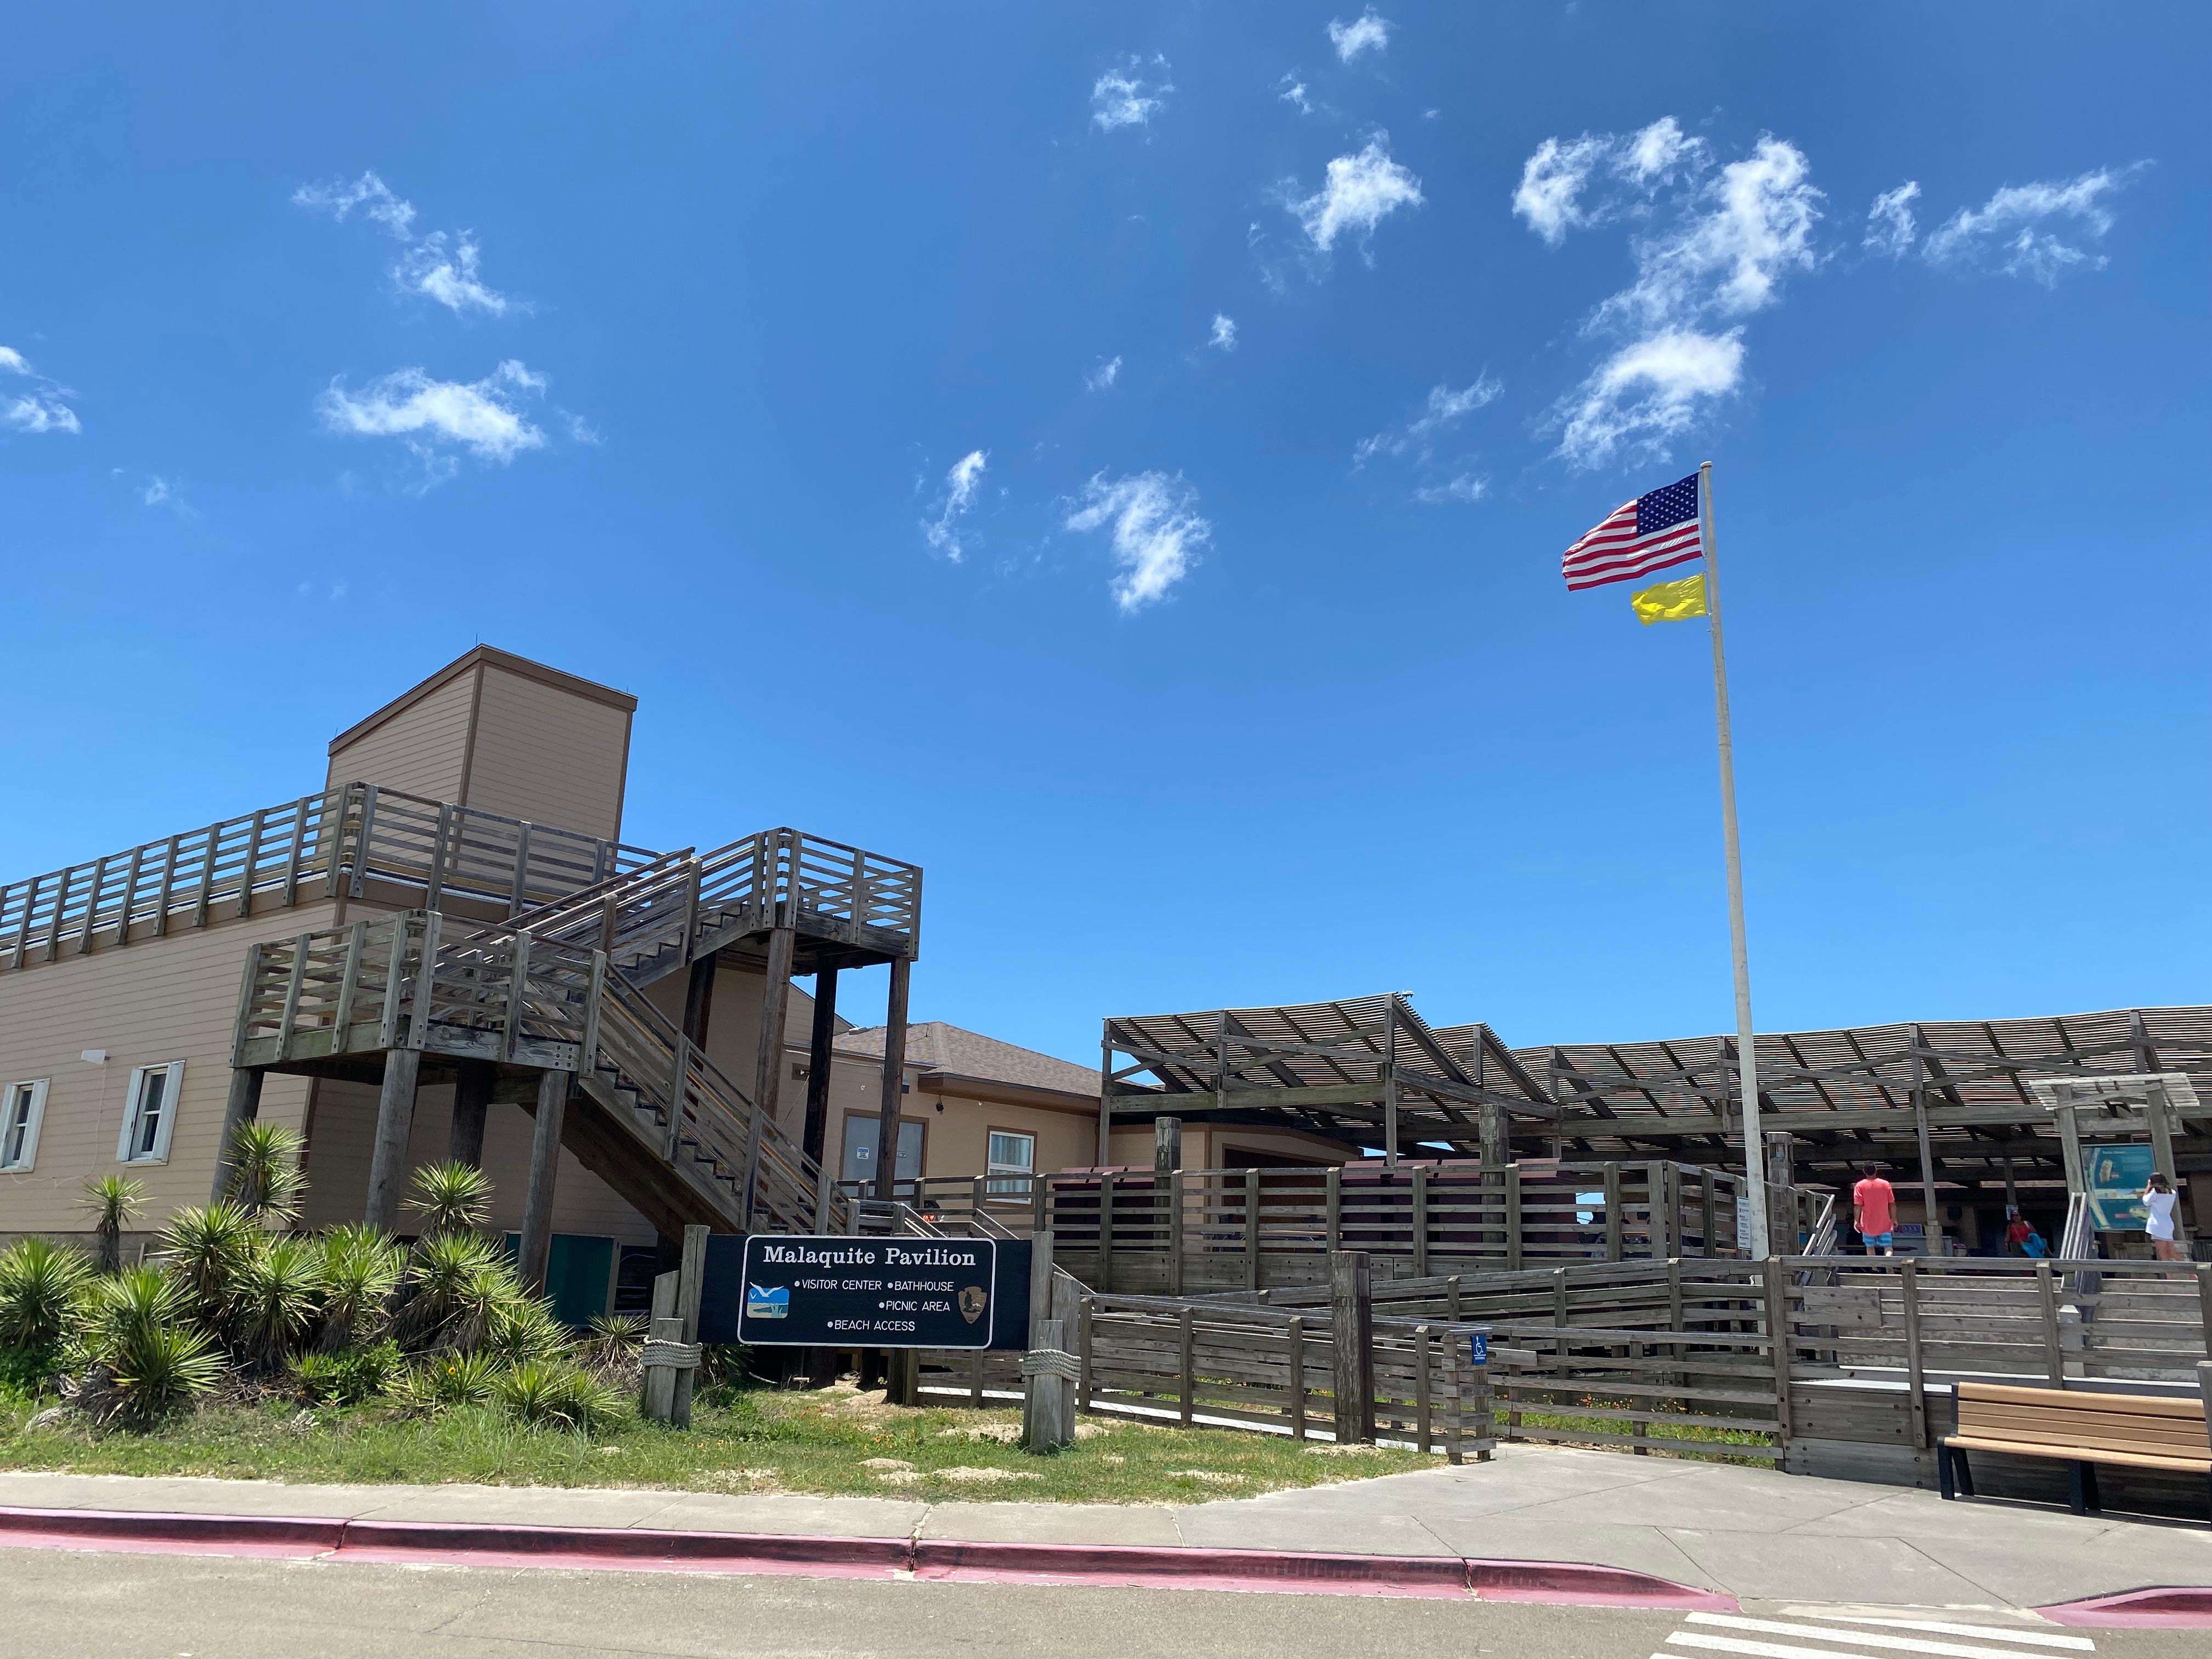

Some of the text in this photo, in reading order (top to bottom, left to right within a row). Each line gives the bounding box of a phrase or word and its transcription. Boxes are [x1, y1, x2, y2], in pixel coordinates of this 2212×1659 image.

[763, 1246, 976, 1268] Malaquite Pavilion
[802, 1279, 882, 1290] VISITOR CENTER
[894, 1280, 954, 1291] BATHHOUSE
[886, 1300, 950, 1312] PICNIC AREA
[834, 1319, 915, 1331] BEACH ACCESS
